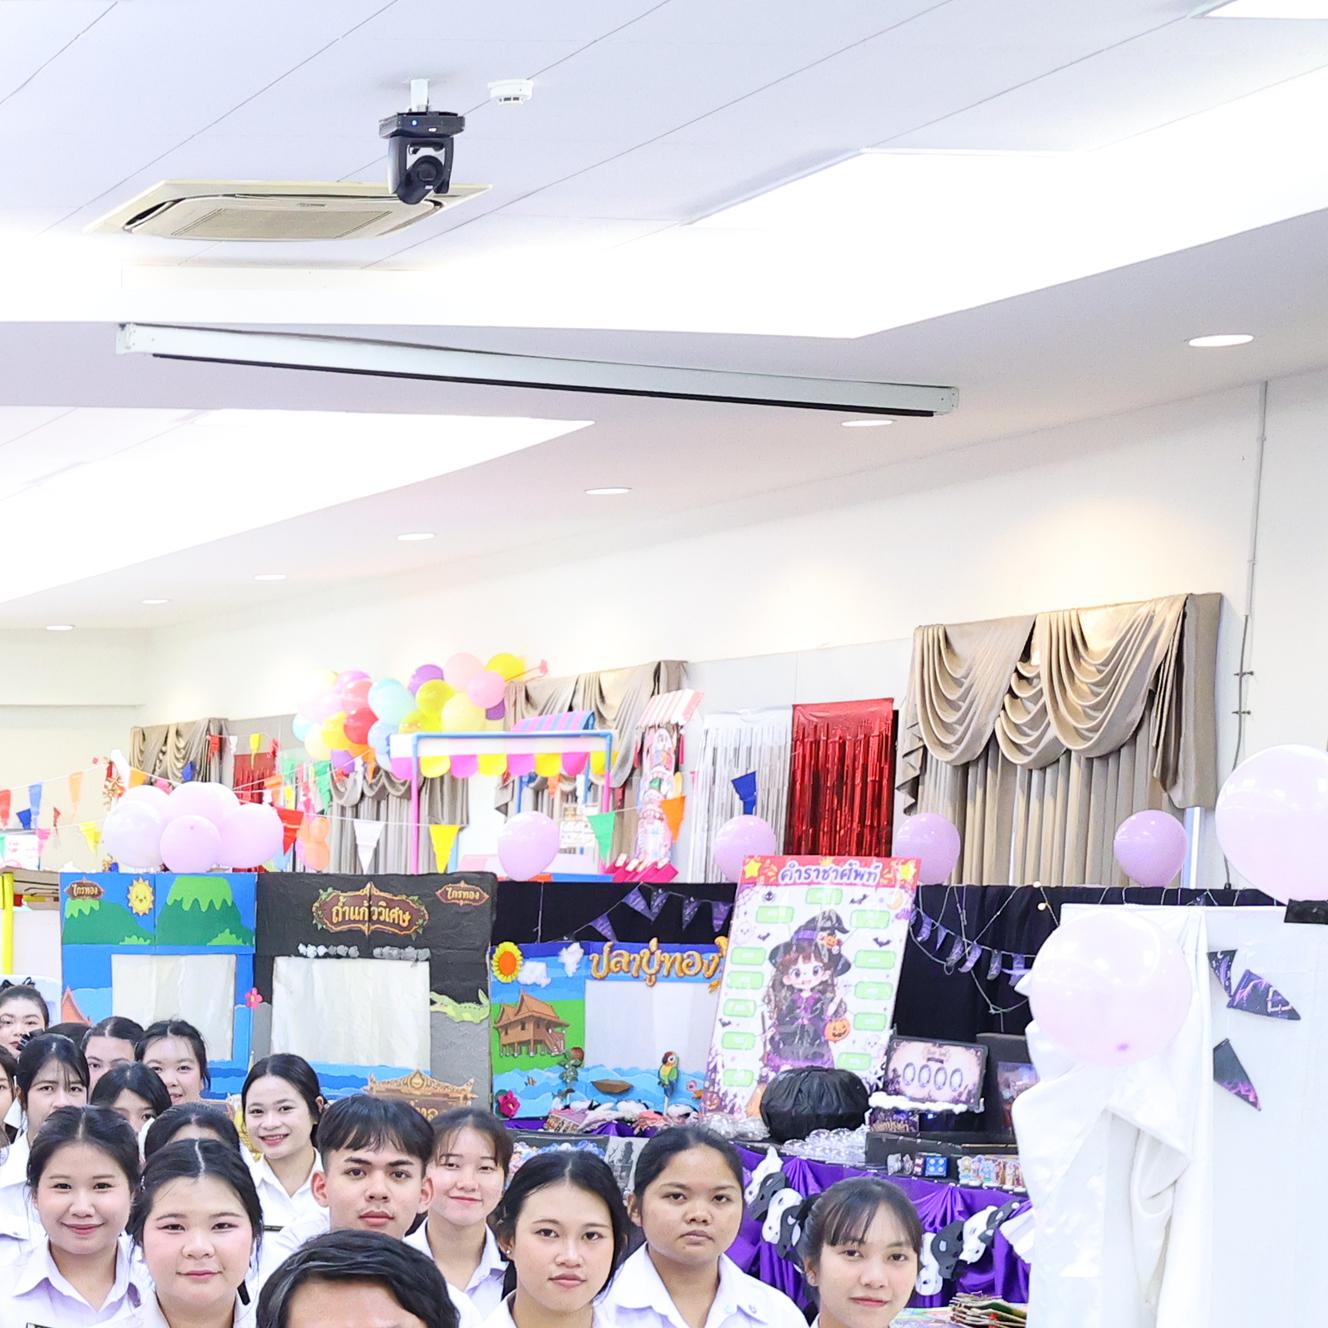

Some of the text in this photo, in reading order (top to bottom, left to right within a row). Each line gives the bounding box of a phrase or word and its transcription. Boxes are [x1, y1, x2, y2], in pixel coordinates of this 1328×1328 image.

[779, 863, 881, 884] คำราชาศัพท์
[446, 887, 480, 900] ไกรทอง
[331, 895, 411, 927] ถ้ำแก้ววิเศษ
[589, 937, 728, 987] ปลาบู่ทอง
